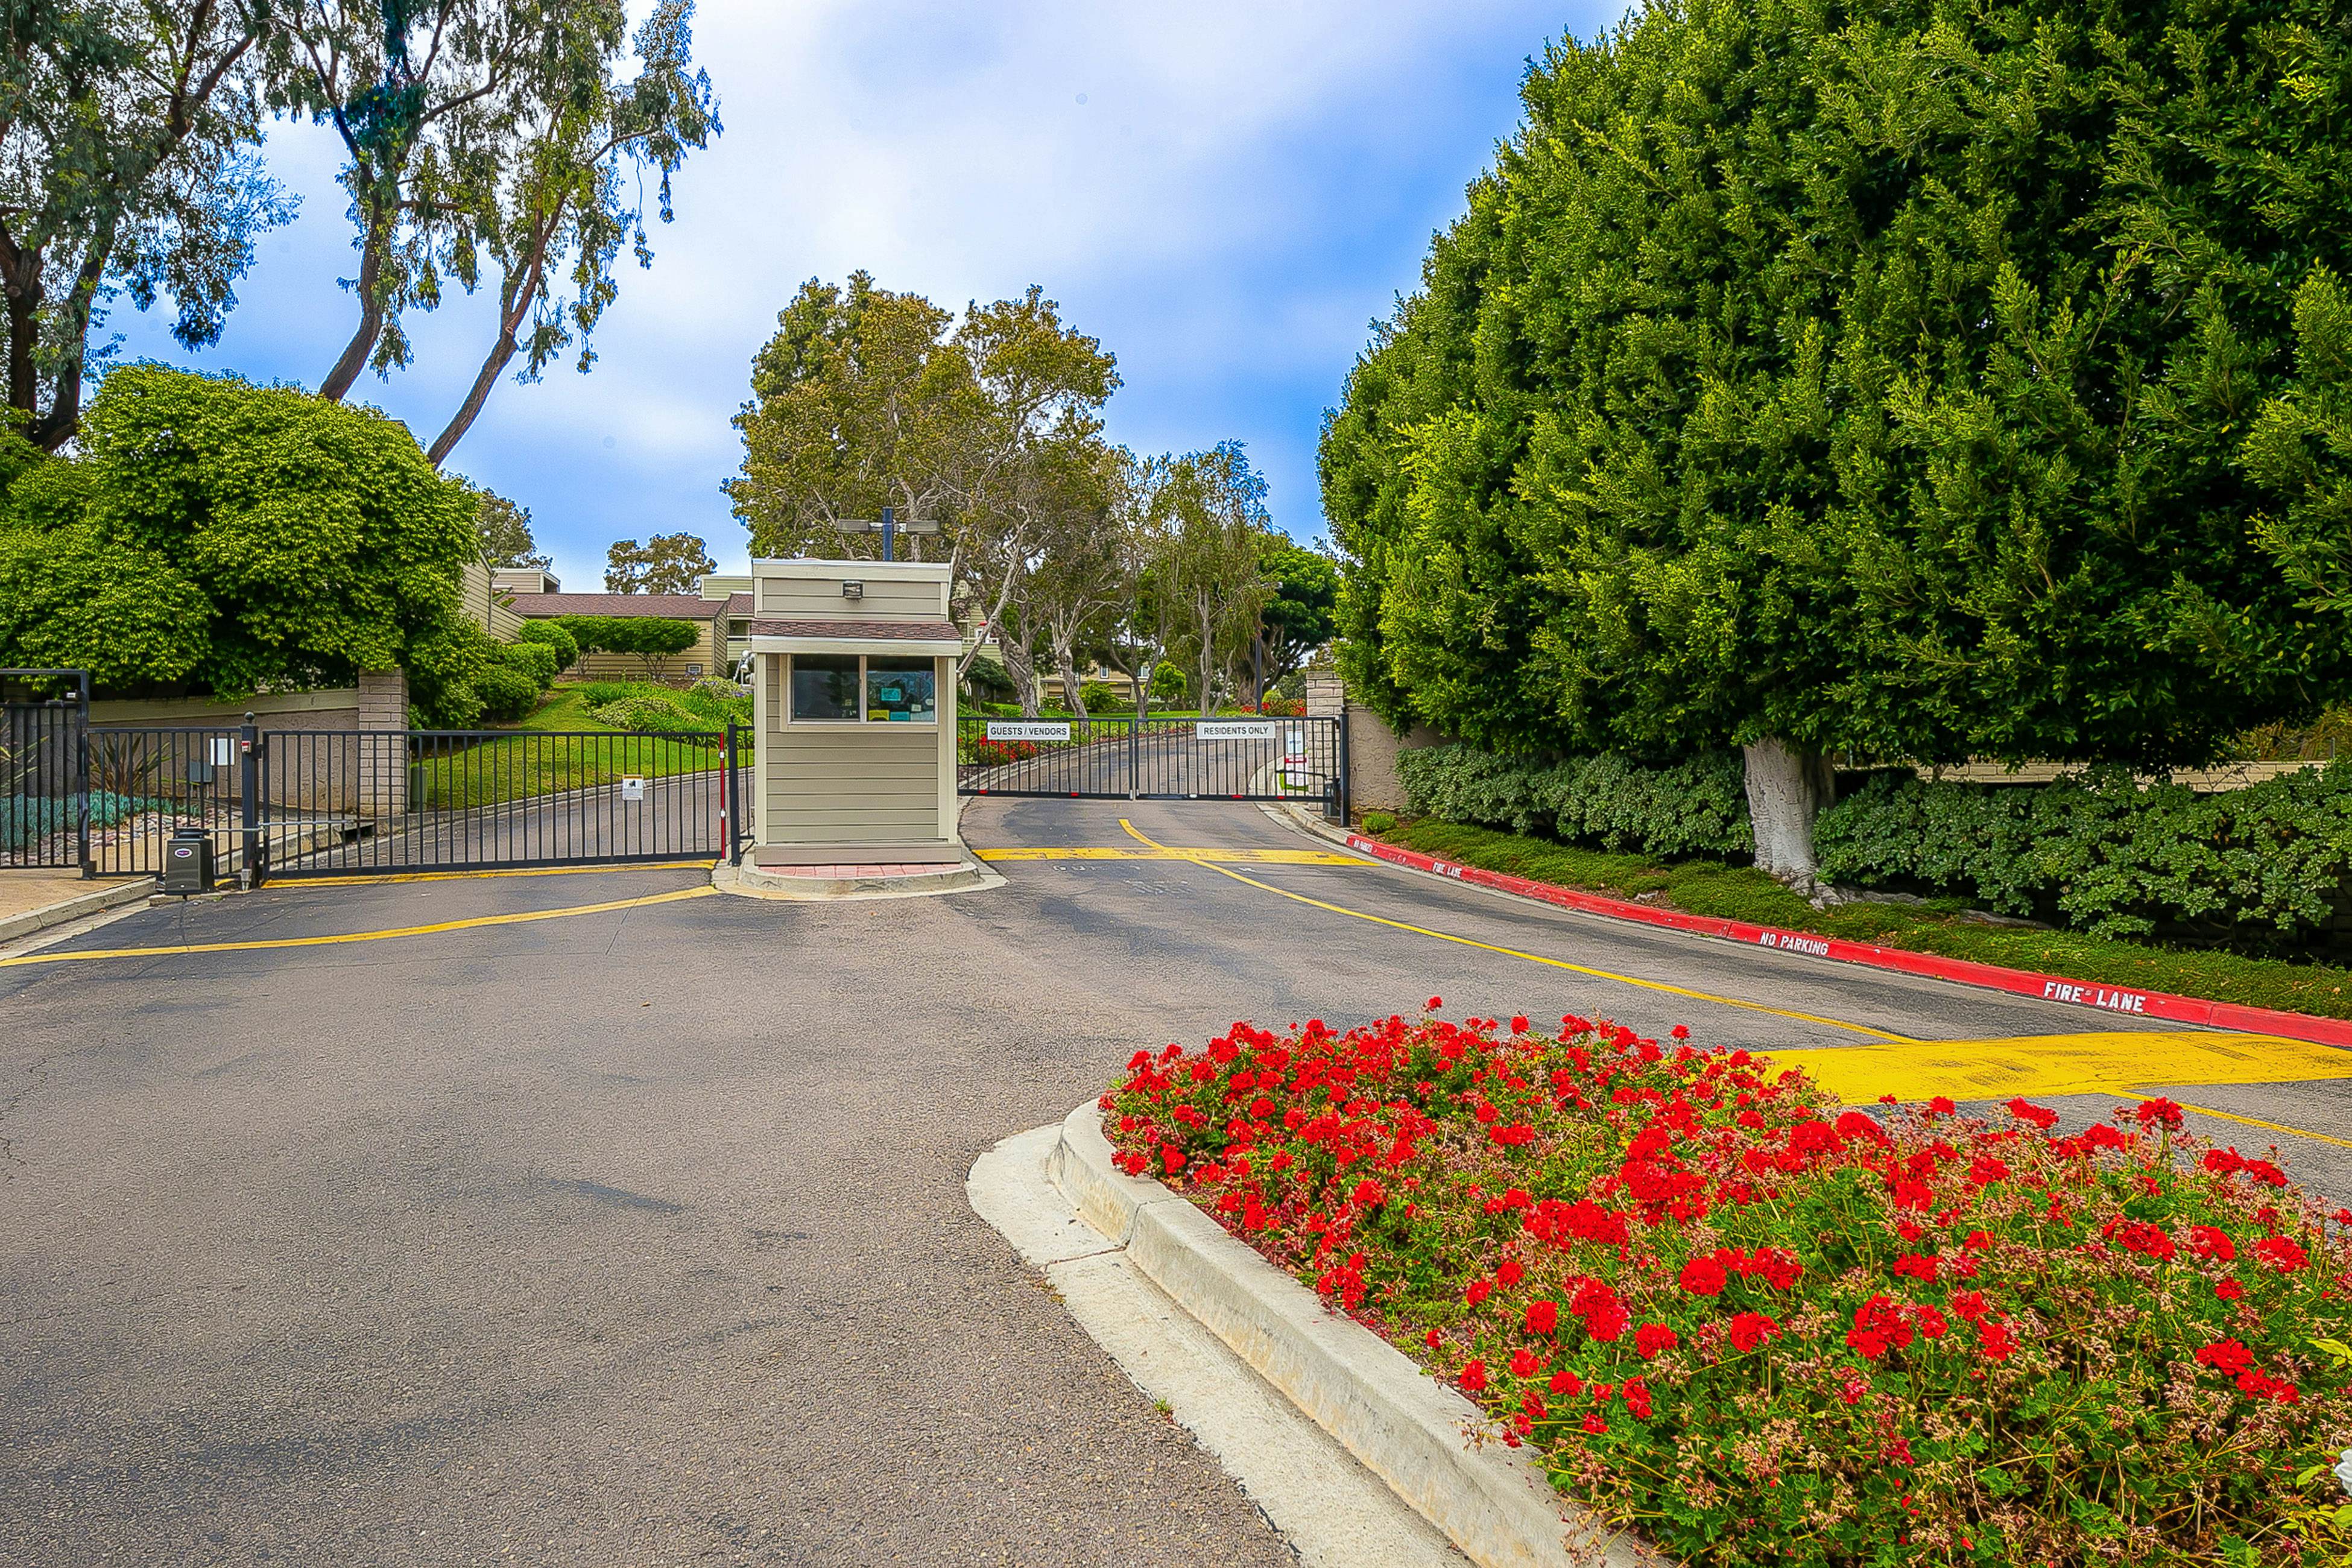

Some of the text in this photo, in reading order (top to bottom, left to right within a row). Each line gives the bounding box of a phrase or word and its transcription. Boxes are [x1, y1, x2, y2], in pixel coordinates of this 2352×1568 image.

[990, 727, 1022, 735] GUESTS
[1204, 727, 1247, 735] RESIDENTS
[1759, 932, 1829, 955] NO PARKING
[2044, 981, 2146, 1012] FIRE LANE
